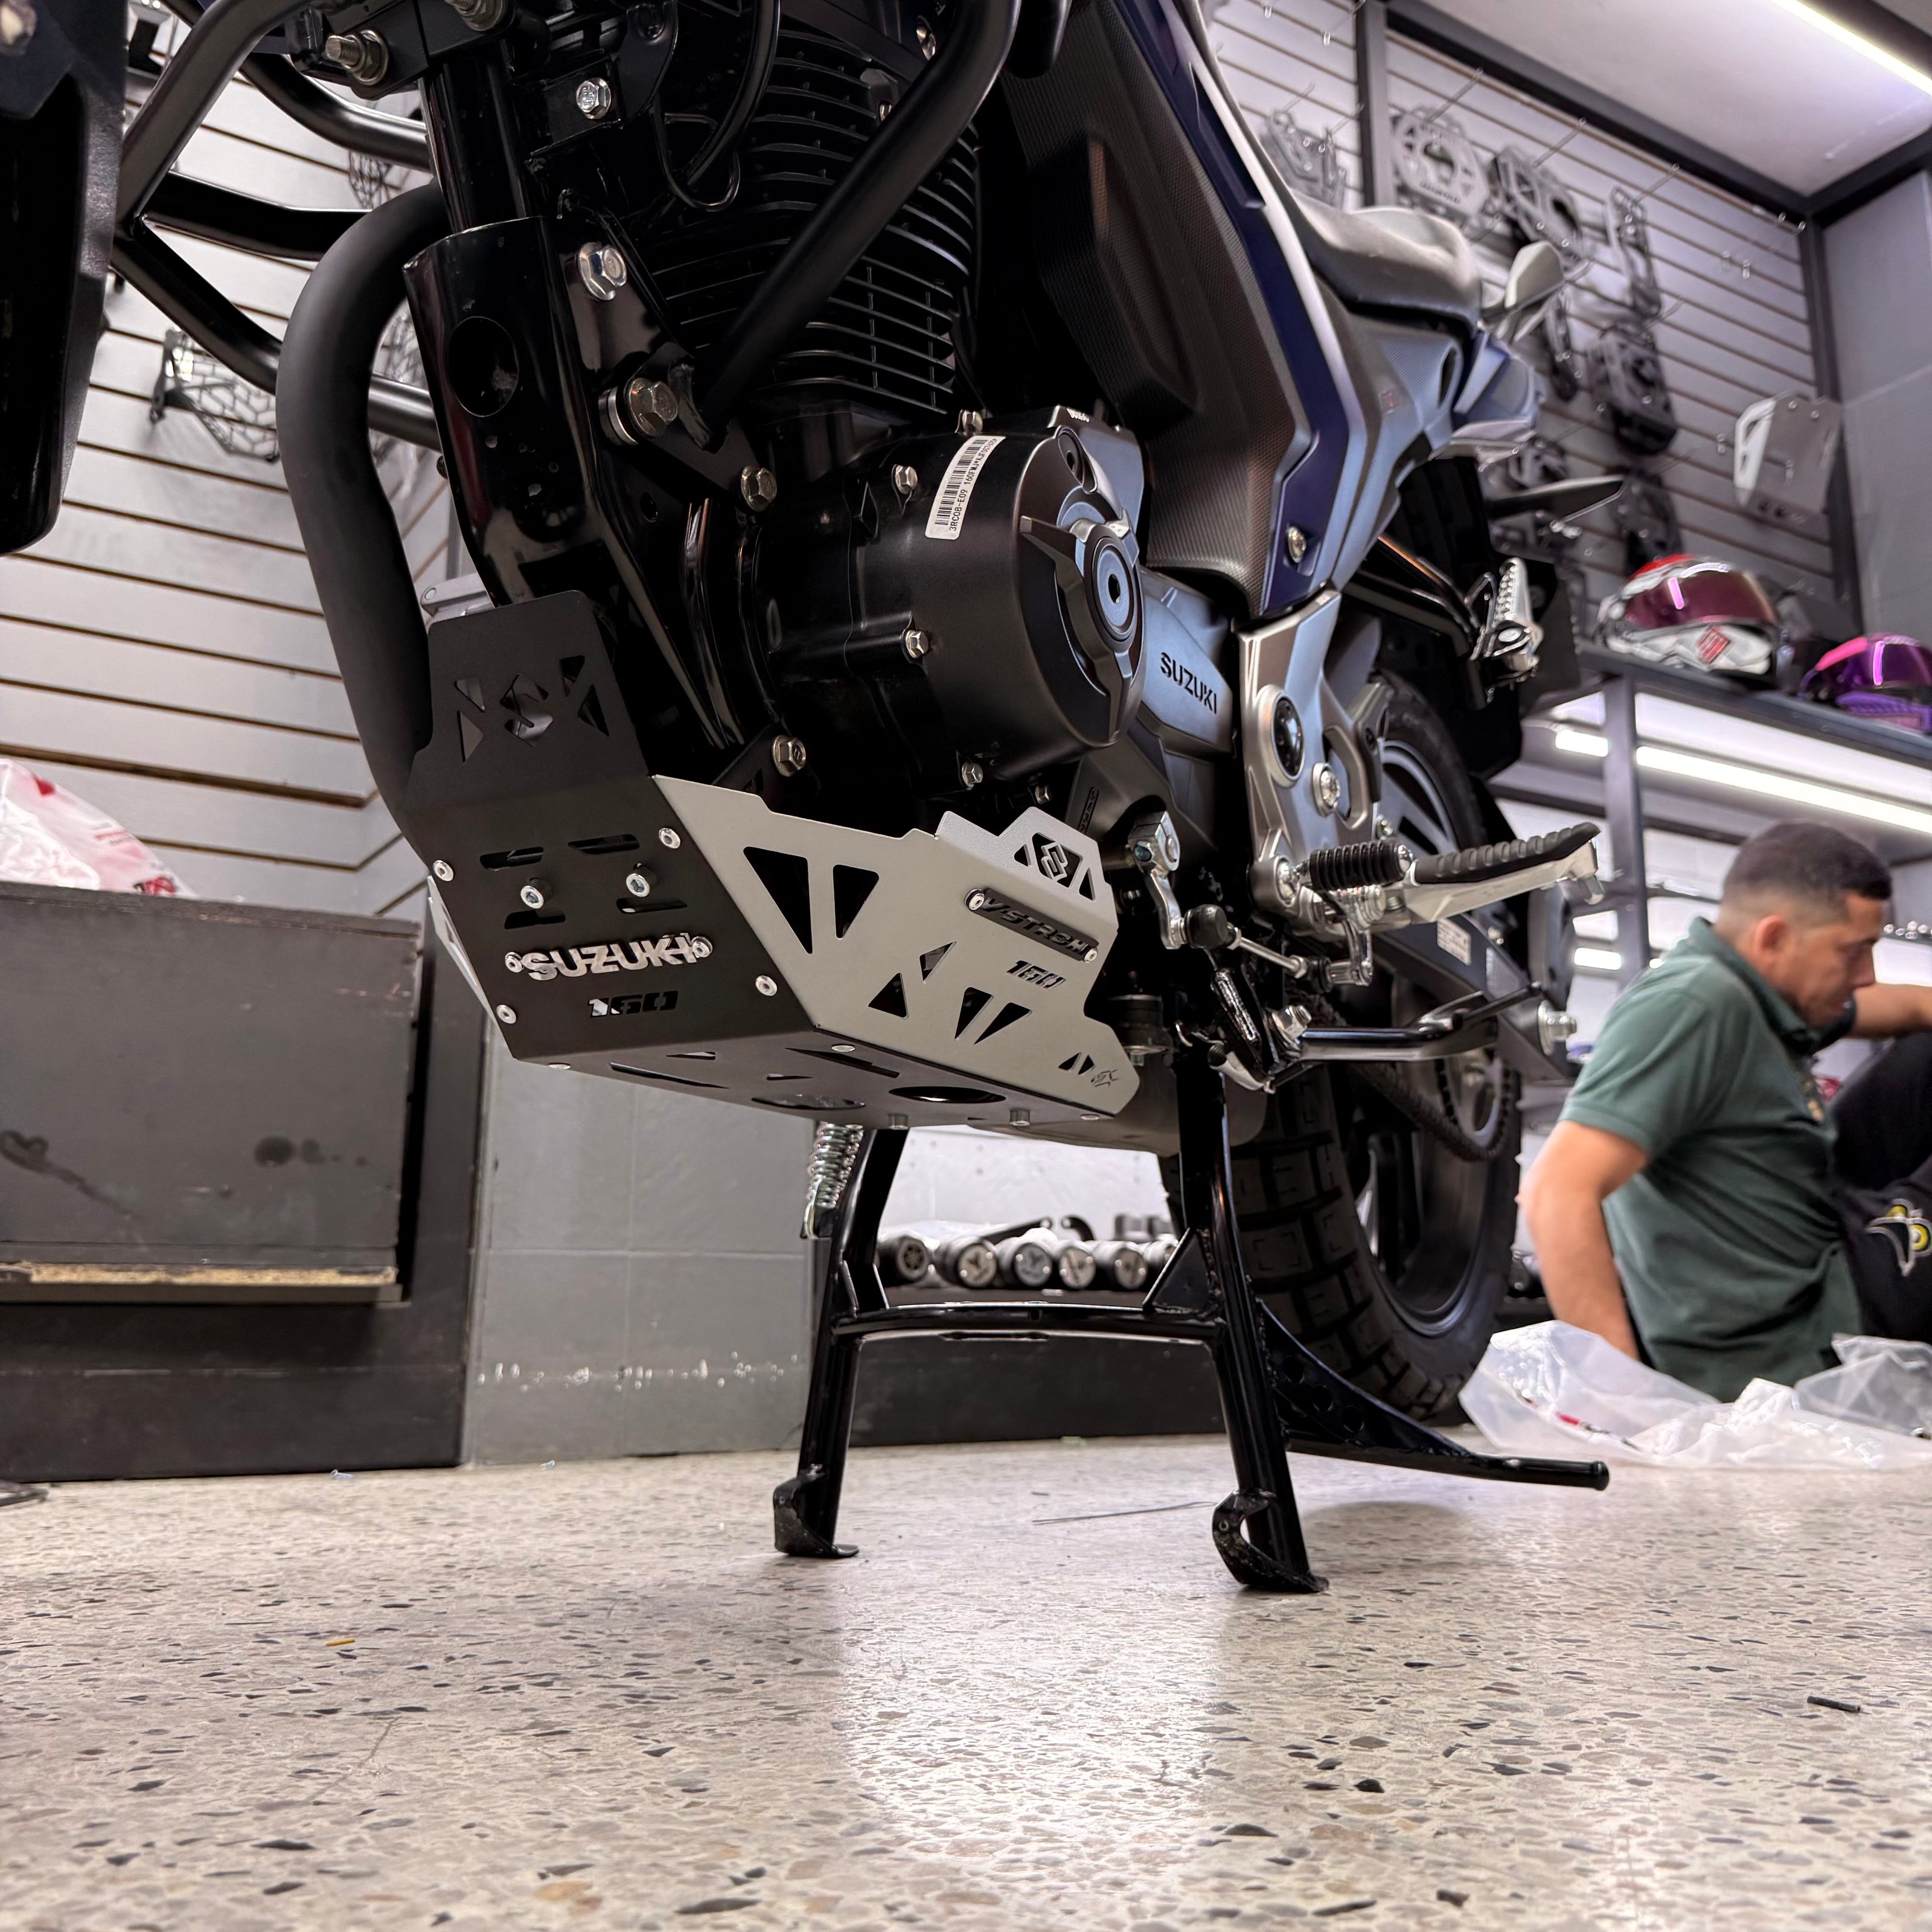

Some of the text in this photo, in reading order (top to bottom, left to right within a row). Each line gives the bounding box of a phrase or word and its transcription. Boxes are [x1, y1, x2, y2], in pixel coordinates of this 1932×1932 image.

[1160, 652, 1217, 715] SUZUKI
[522, 936, 697, 980] SUZUKI
[588, 991, 679, 1018] 160
